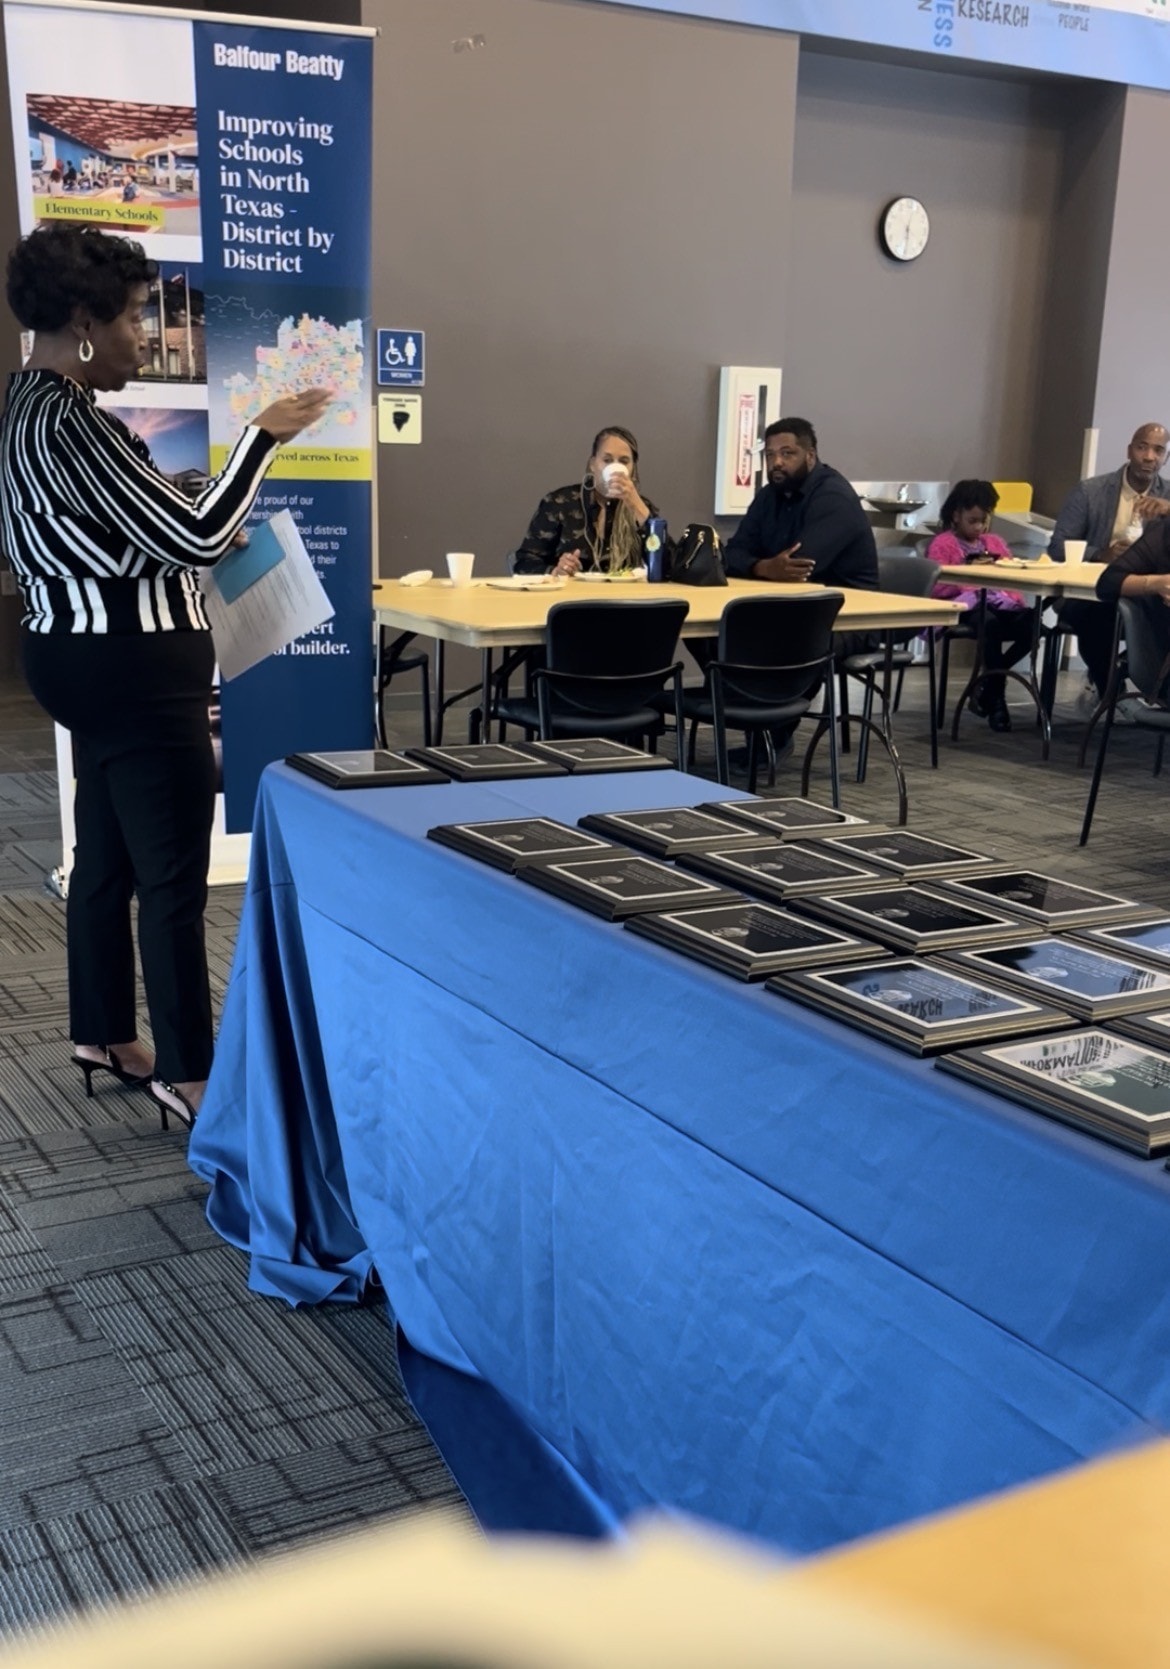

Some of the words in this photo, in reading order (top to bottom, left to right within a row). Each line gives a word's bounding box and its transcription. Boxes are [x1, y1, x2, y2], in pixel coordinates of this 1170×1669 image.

[933, 0, 954, 48] ESS
[957, 0, 1030, 28] RESEARCH
[213, 43, 281, 72] Balfour
[285, 50, 345, 81] Beatty
[217, 110, 334, 146] Improving
[218, 139, 304, 166] Schools
[220, 165, 242, 188] in
[247, 168, 310, 193] North
[45, 203, 112, 220] Elementary
[115, 208, 159, 222] Schools
[221, 194, 285, 219] Texas
[222, 221, 302, 247] District
[307, 227, 335, 254] by
[223, 249, 303, 273] District
[275, 452, 298, 461] rved
[300, 454, 331, 462] across
[334, 453, 359, 463] Texas
[263, 494, 288, 507] proud
[289, 494, 298, 506] of
[300, 497, 314, 506] our
[313, 525, 348, 536] districts
[305, 539, 329, 551] Texas
[330, 540, 340, 550] to
[317, 555, 337, 565] their
[290, 640, 350, 655] builder.
